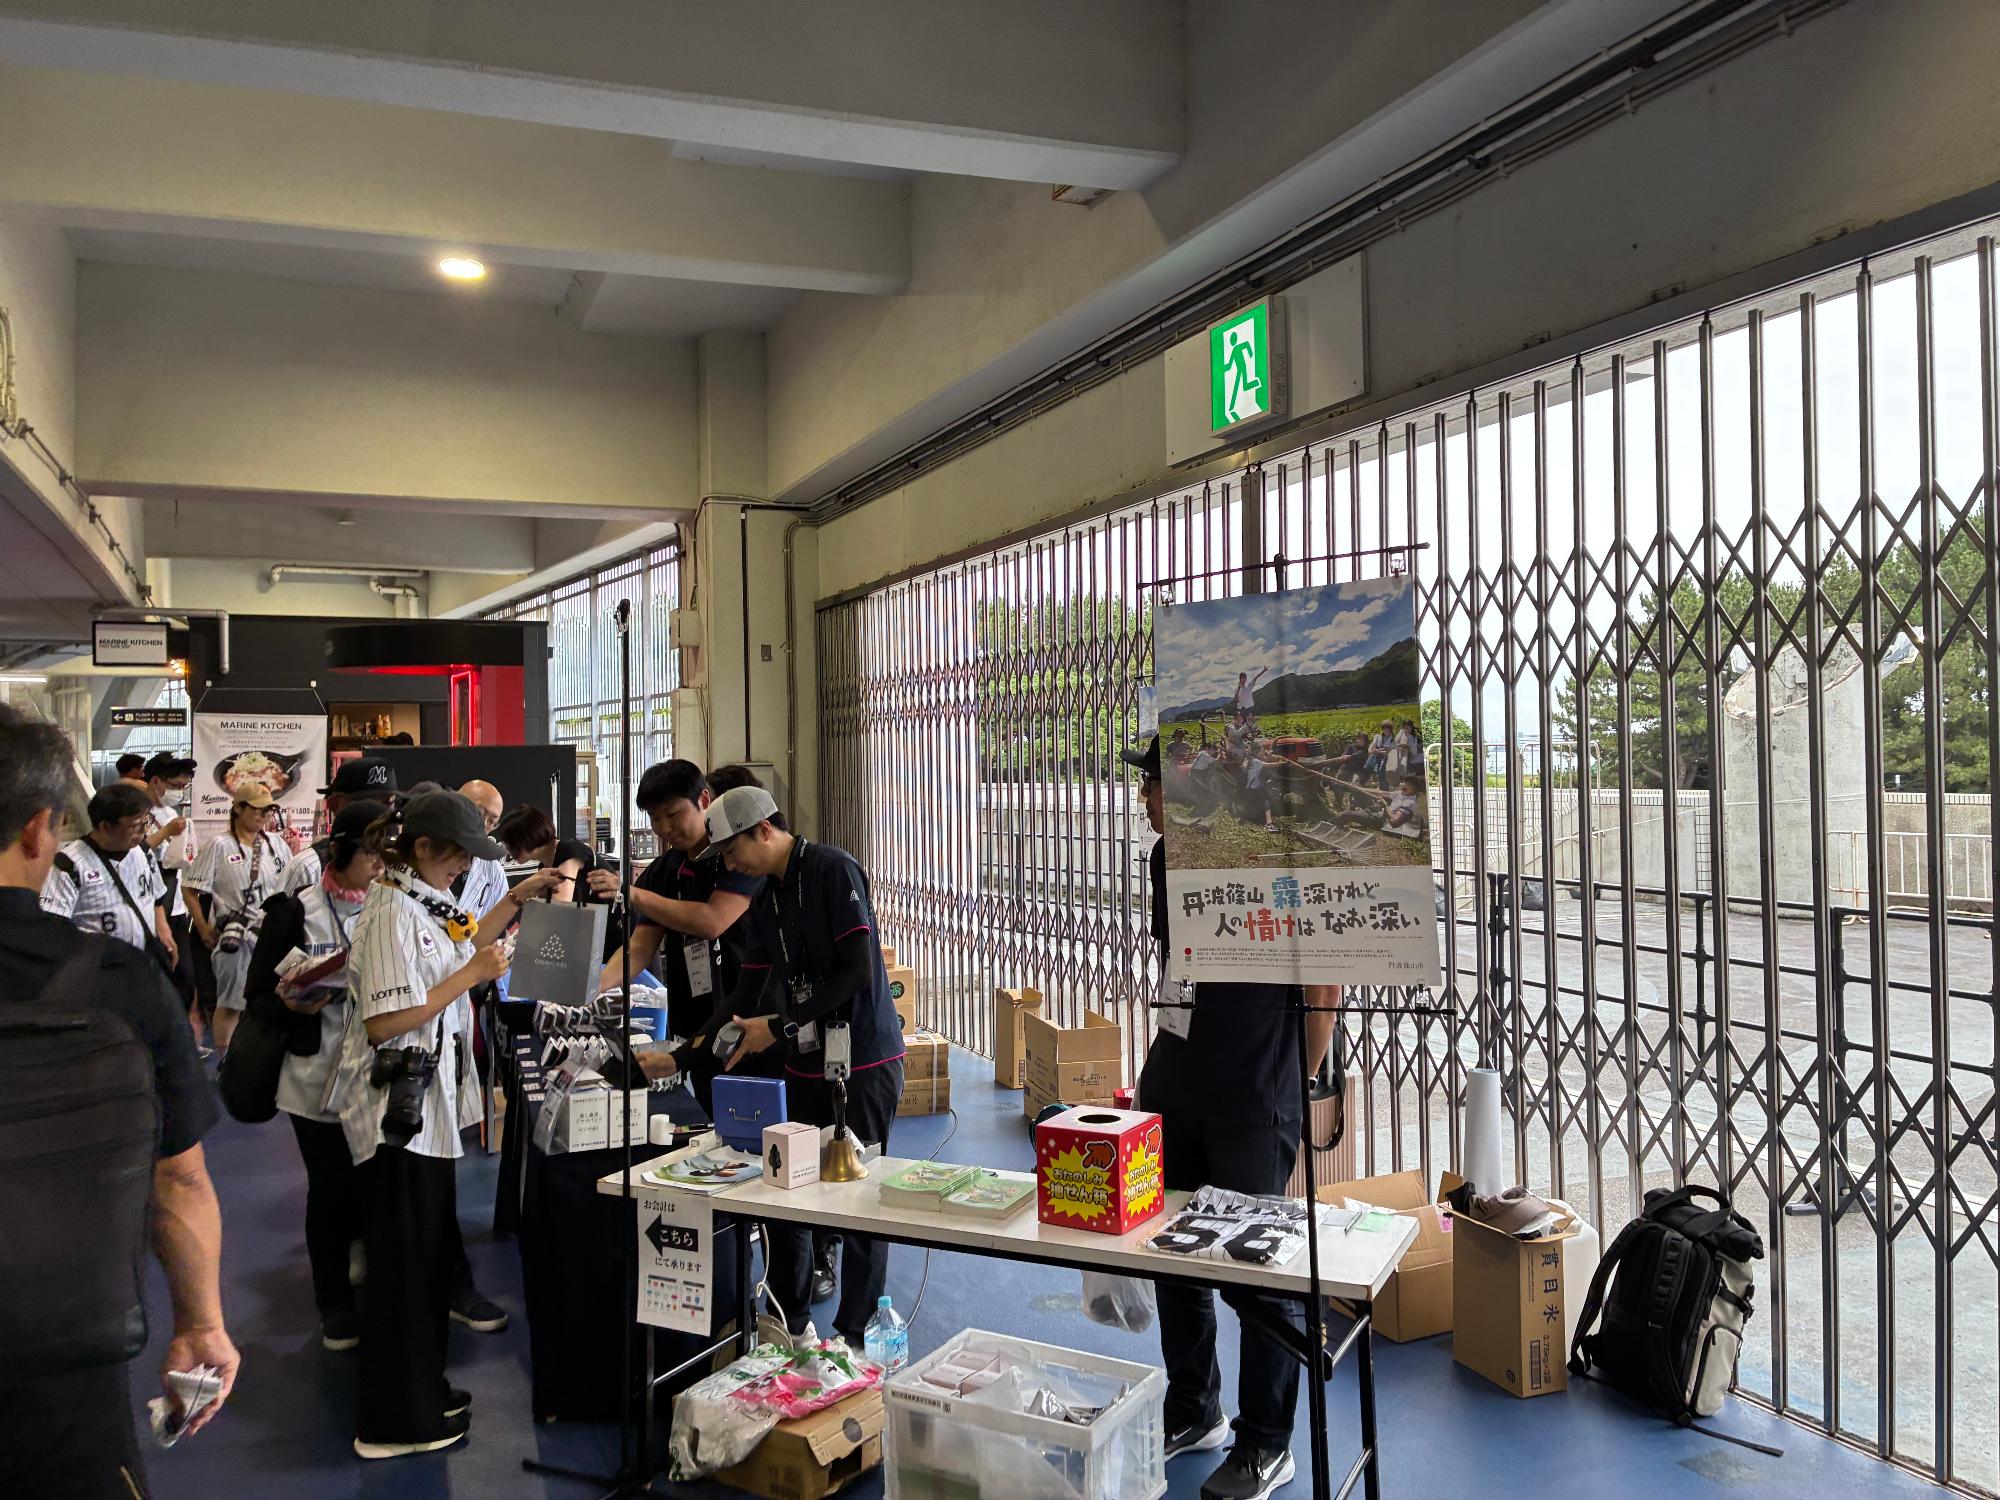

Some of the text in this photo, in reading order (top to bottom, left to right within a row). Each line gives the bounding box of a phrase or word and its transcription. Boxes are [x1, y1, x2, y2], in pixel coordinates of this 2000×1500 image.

[99, 638, 128, 646] MARINE
[130, 639, 163, 647] KITCHEN
[220, 721, 302, 730] MARINE KITCHEN
[1182, 875, 1380, 918] 丹波篠山 霧深けれど
[101, 912, 116, 933] 6
[1214, 901, 1421, 942] 人の情けは なお深い
[370, 985, 413, 1001] LOTTE
[1052, 1167, 1104, 1185] おたのしみ
[1128, 1159, 1156, 1182] おたのしみ
[1049, 1181, 1109, 1206] 抽せん箱
[1127, 1173, 1160, 1202] 抽せん箱
[643, 1199, 676, 1213] お会計は
[660, 1228, 694, 1247] こちら
[655, 1256, 702, 1272] にて承ります
